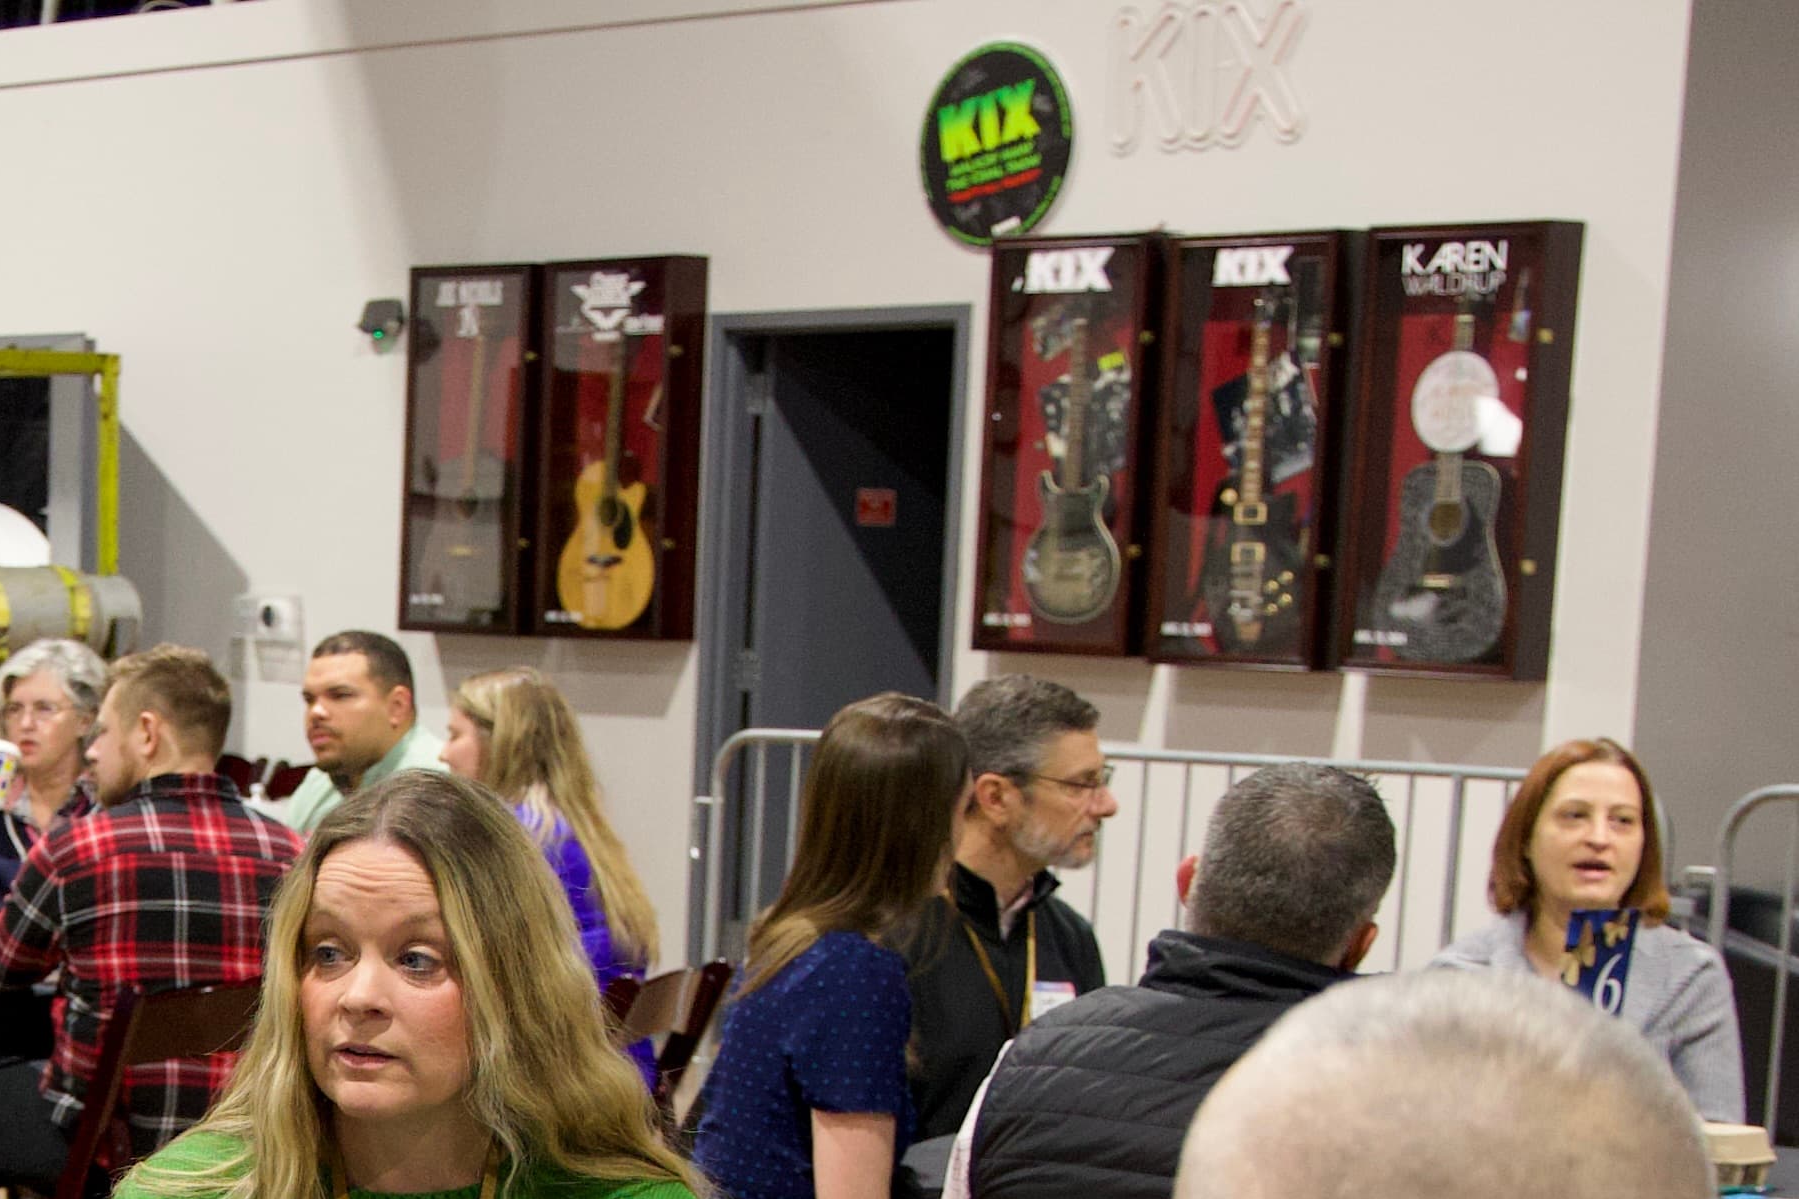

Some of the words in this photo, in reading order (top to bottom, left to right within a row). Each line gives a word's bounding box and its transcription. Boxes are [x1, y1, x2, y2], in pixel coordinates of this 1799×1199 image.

[937, 78, 1041, 162] KIX
[1024, 247, 1115, 293] KIX
[1212, 246, 1294, 287] KIX
[1401, 240, 1508, 275] KAREN
[1593, 953, 1621, 1016] 6
